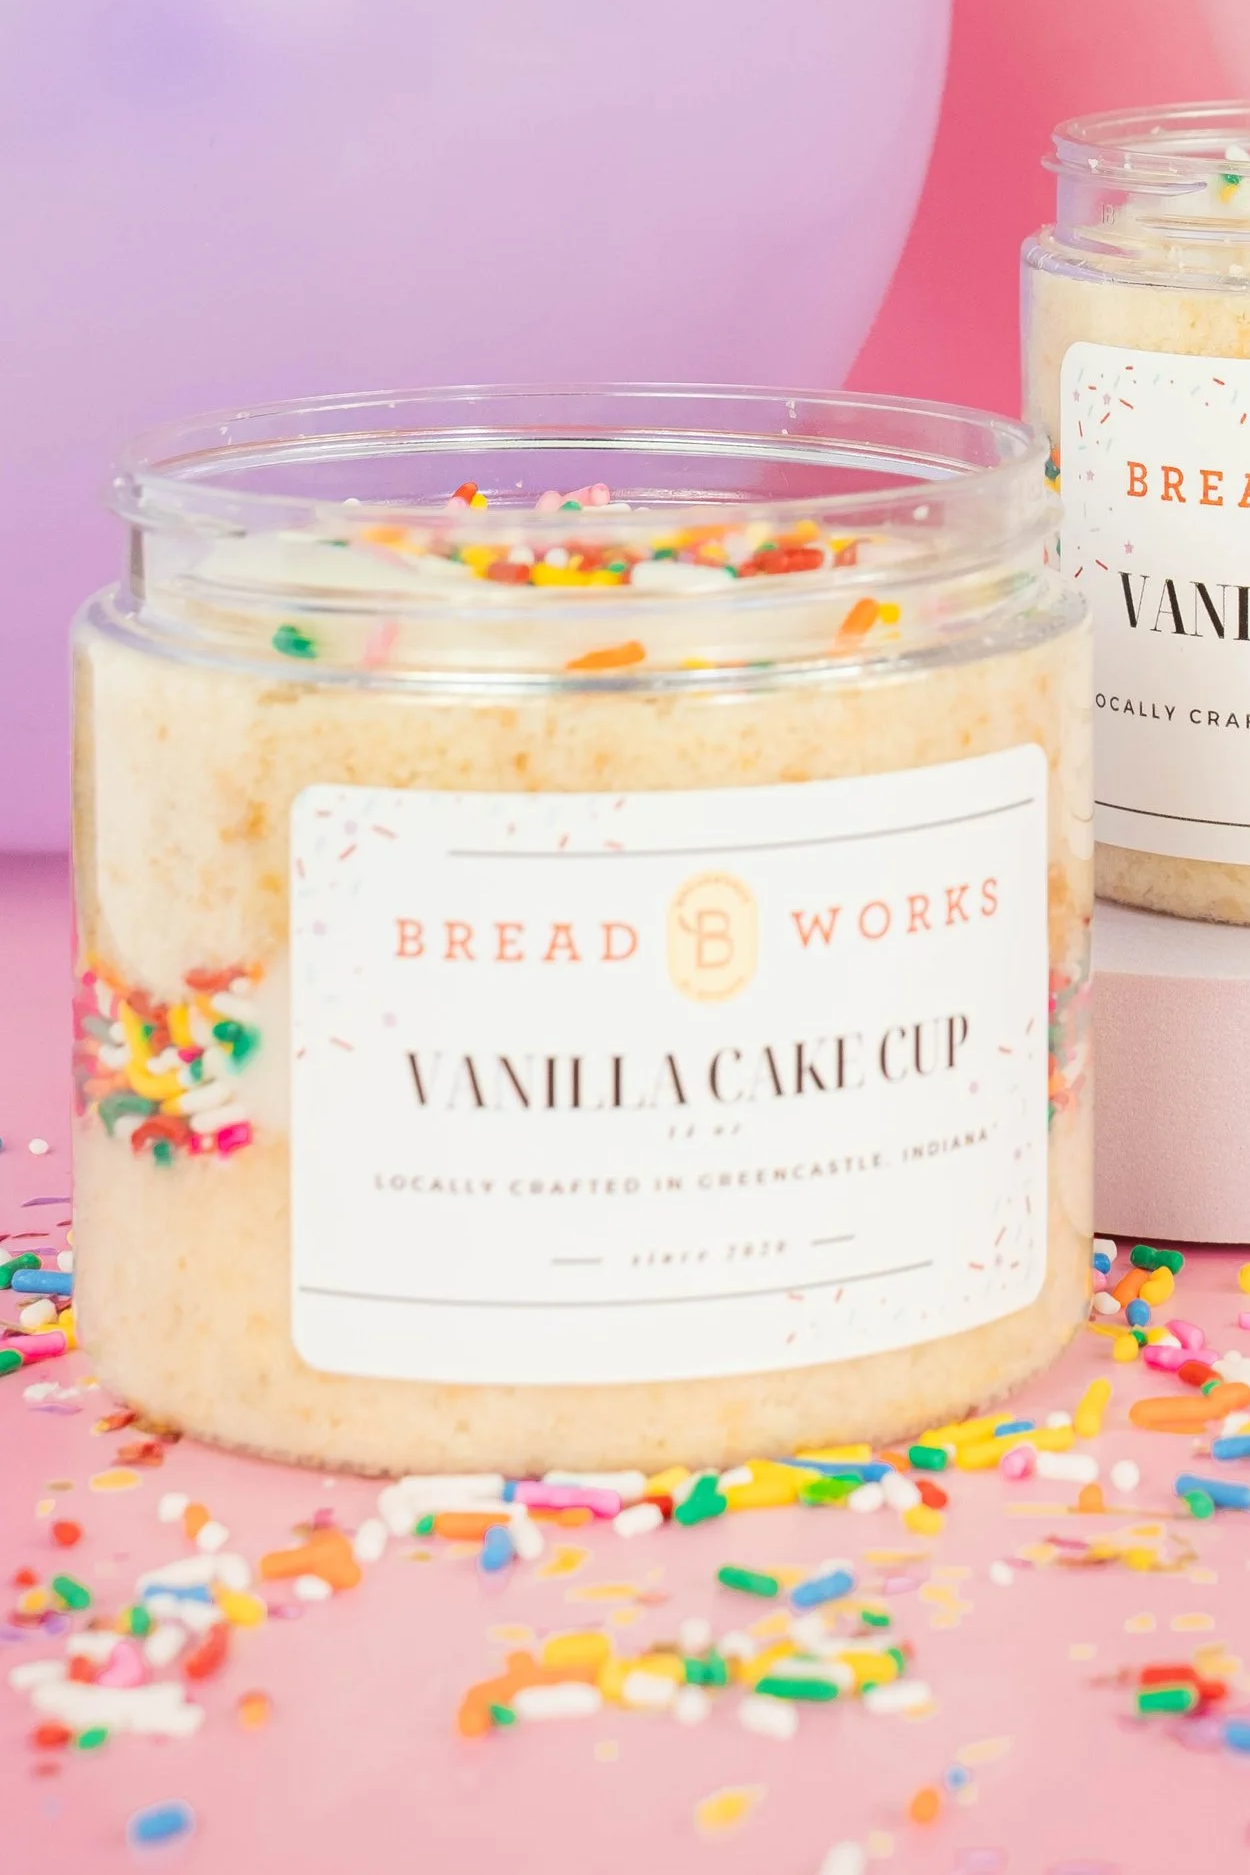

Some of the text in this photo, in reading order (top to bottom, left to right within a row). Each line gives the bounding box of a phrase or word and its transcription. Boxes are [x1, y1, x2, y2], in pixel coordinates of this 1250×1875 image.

[1095, 693, 1175, 721] OCALLY
[395, 919, 638, 964] BREAD
[791, 877, 999, 948] WORKS
[677, 908, 735, 969] B
[404, 1012, 970, 1111] VANILLA CAKE CUP
[374, 1173, 496, 1196] LOCALLY
[507, 1176, 641, 1198] CRAFTED
[653, 1176, 684, 1193] IN
[902, 1127, 988, 1162] INDIANA
